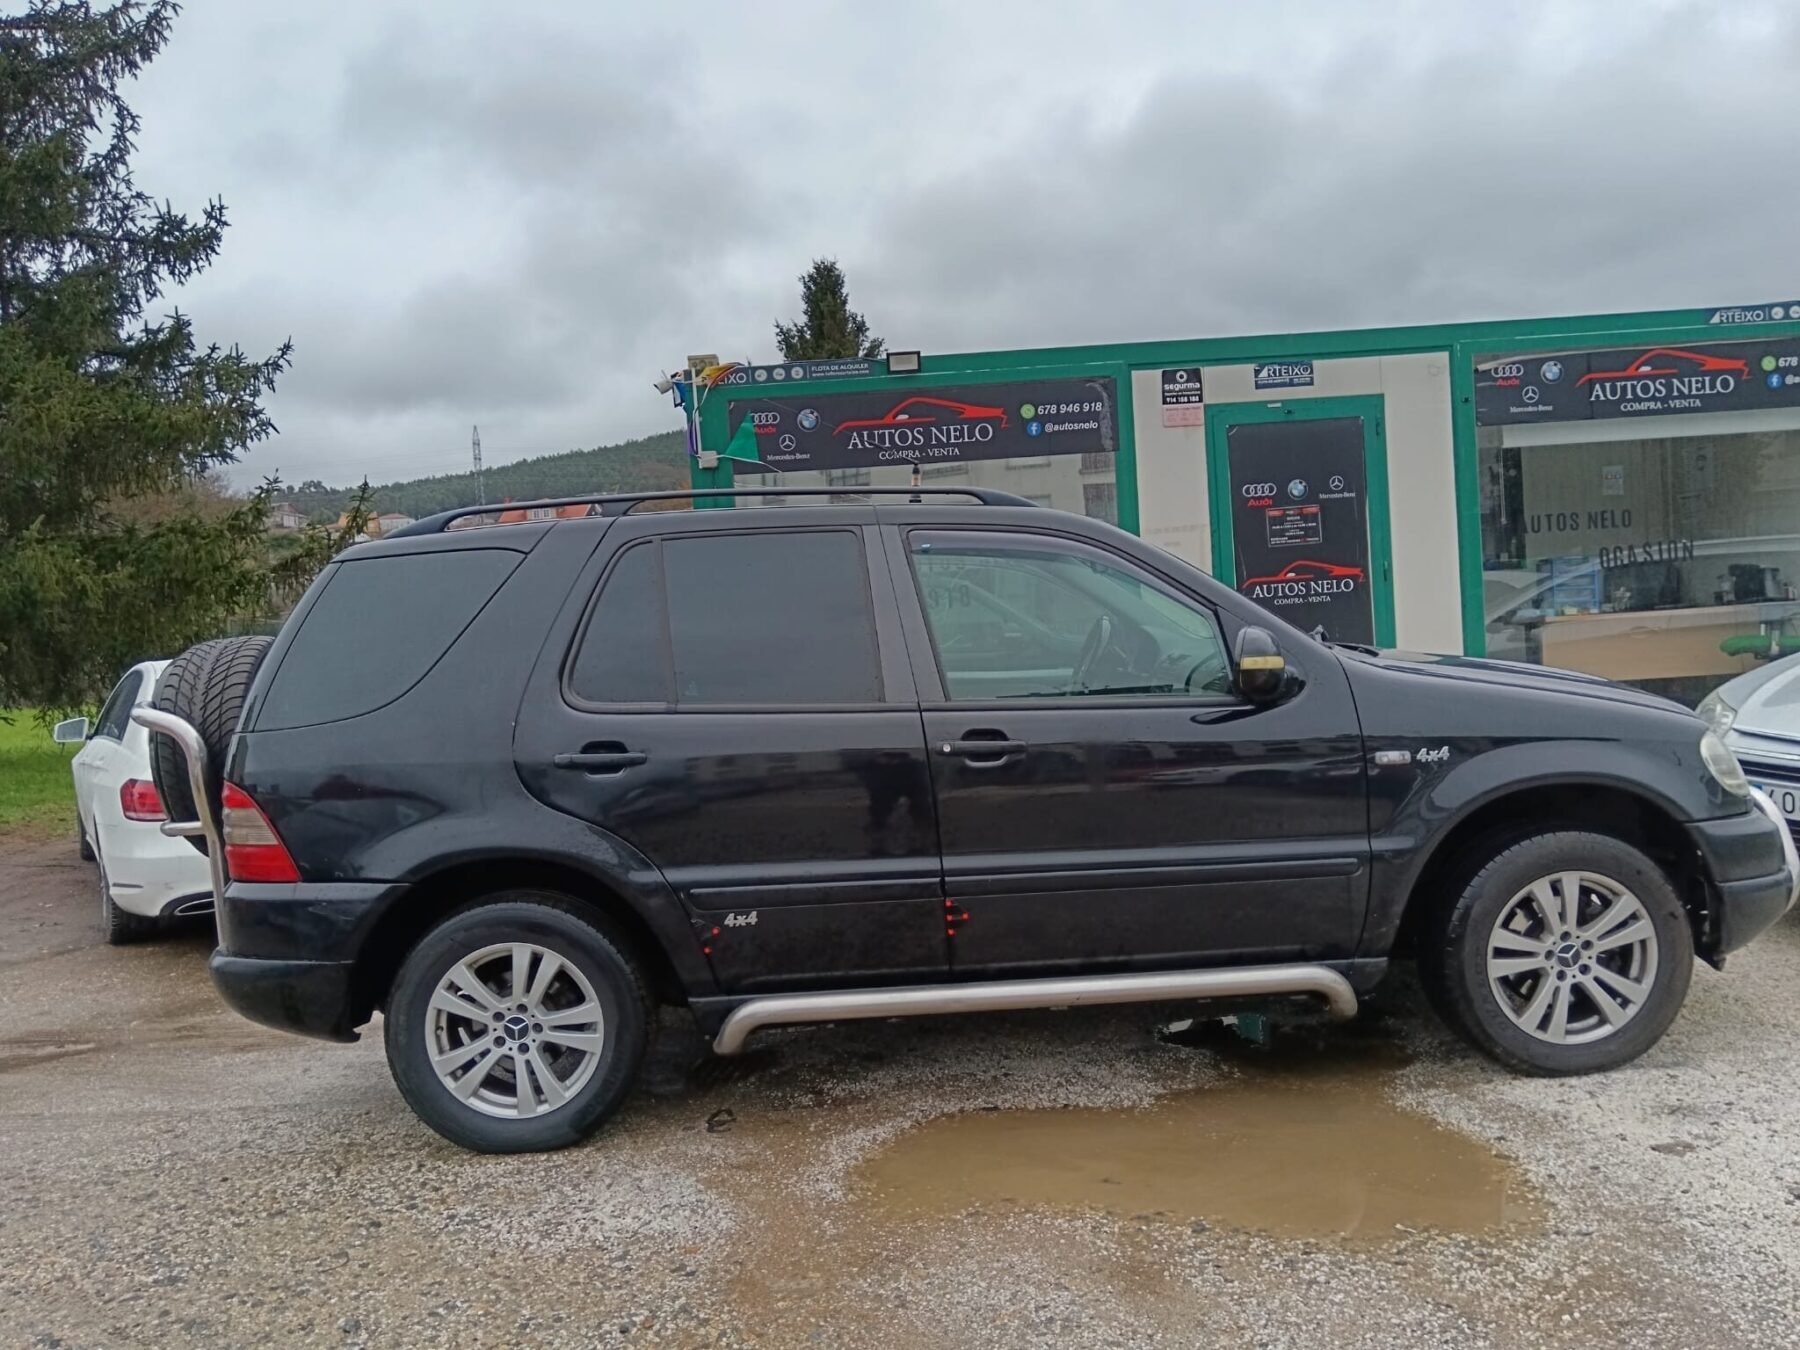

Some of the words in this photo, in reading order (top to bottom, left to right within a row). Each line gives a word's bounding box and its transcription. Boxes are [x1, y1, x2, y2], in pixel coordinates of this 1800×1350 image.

[1710, 310, 1764, 324] ARTEIXO
[1778, 357, 1798, 367] 678
[1258, 365, 1311, 377] ARTEIXO
[1164, 382, 1200, 391] segurma
[1590, 379, 1666, 401] AUTOS
[1672, 374, 1735, 396] NELO
[1037, 404, 1057, 415] 678
[1059, 403, 1080, 413] 946
[1082, 402, 1103, 412] 918
[1620, 400, 1662, 411] COMPRA
[1668, 399, 1702, 409] VENTA
[1044, 420, 1098, 433] @autosnelo
[848, 427, 924, 449] AUTOS
[930, 423, 993, 444] NELO
[879, 449, 920, 460] COMPRA
[927, 447, 960, 457] VENTA
[1587, 509, 1632, 530] NELO
[1600, 540, 1694, 569] OCASION
[1252, 582, 1306, 598] AUTOS
[1310, 579, 1354, 594] NELO
[1274, 598, 1304, 606] COMPRA
[1416, 746, 1450, 762] 4x4
[724, 911, 758, 927] 4x4
